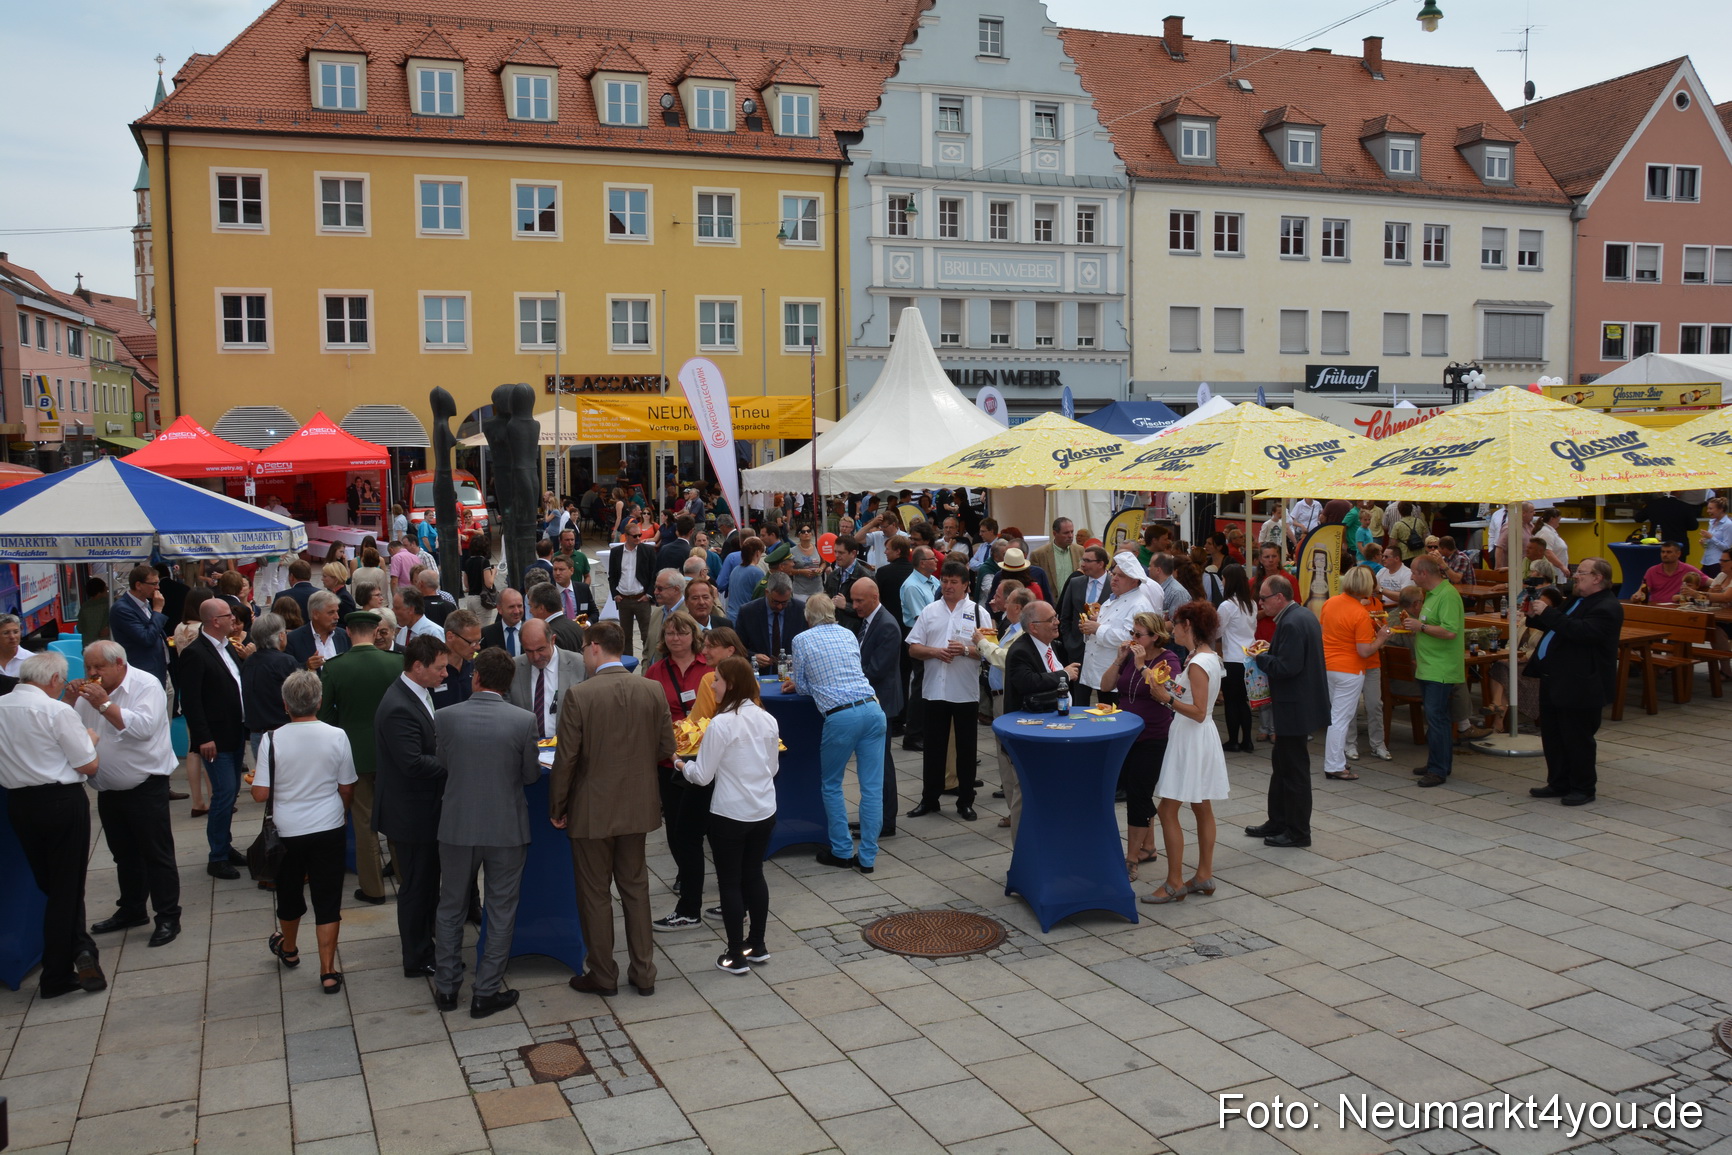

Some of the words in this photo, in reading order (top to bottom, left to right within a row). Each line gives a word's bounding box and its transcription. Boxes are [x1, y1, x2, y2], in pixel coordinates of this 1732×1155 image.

[944, 260, 1000, 277] BRILLEN
[1003, 262, 1054, 279] WEBER
[943, 369, 998, 386] RILLEN
[1000, 369, 1063, 387] WEBER
[1310, 366, 1377, 390] frühauf
[1612, 386, 1664, 405] Glossner-Bier
[649, 424, 682, 433] Vortrag,
[731, 423, 771, 432] Gespräche
[1052, 443, 1123, 469] Glossner
[1263, 439, 1341, 470] Glossner
[1352, 437, 1496, 478] Glossner
[1550, 430, 1640, 472] Glossner
[1622, 451, 1676, 467] Bier
[1400, 459, 1459, 477] Bier
[74, 537, 143, 547] NEUMARKTER
[169, 534, 221, 545] NEUMARKTER
[232, 531, 284, 543] NEUMARKTER
[87, 548, 132, 556] Nachrichten
[241, 543, 276, 551] Nachrichten
